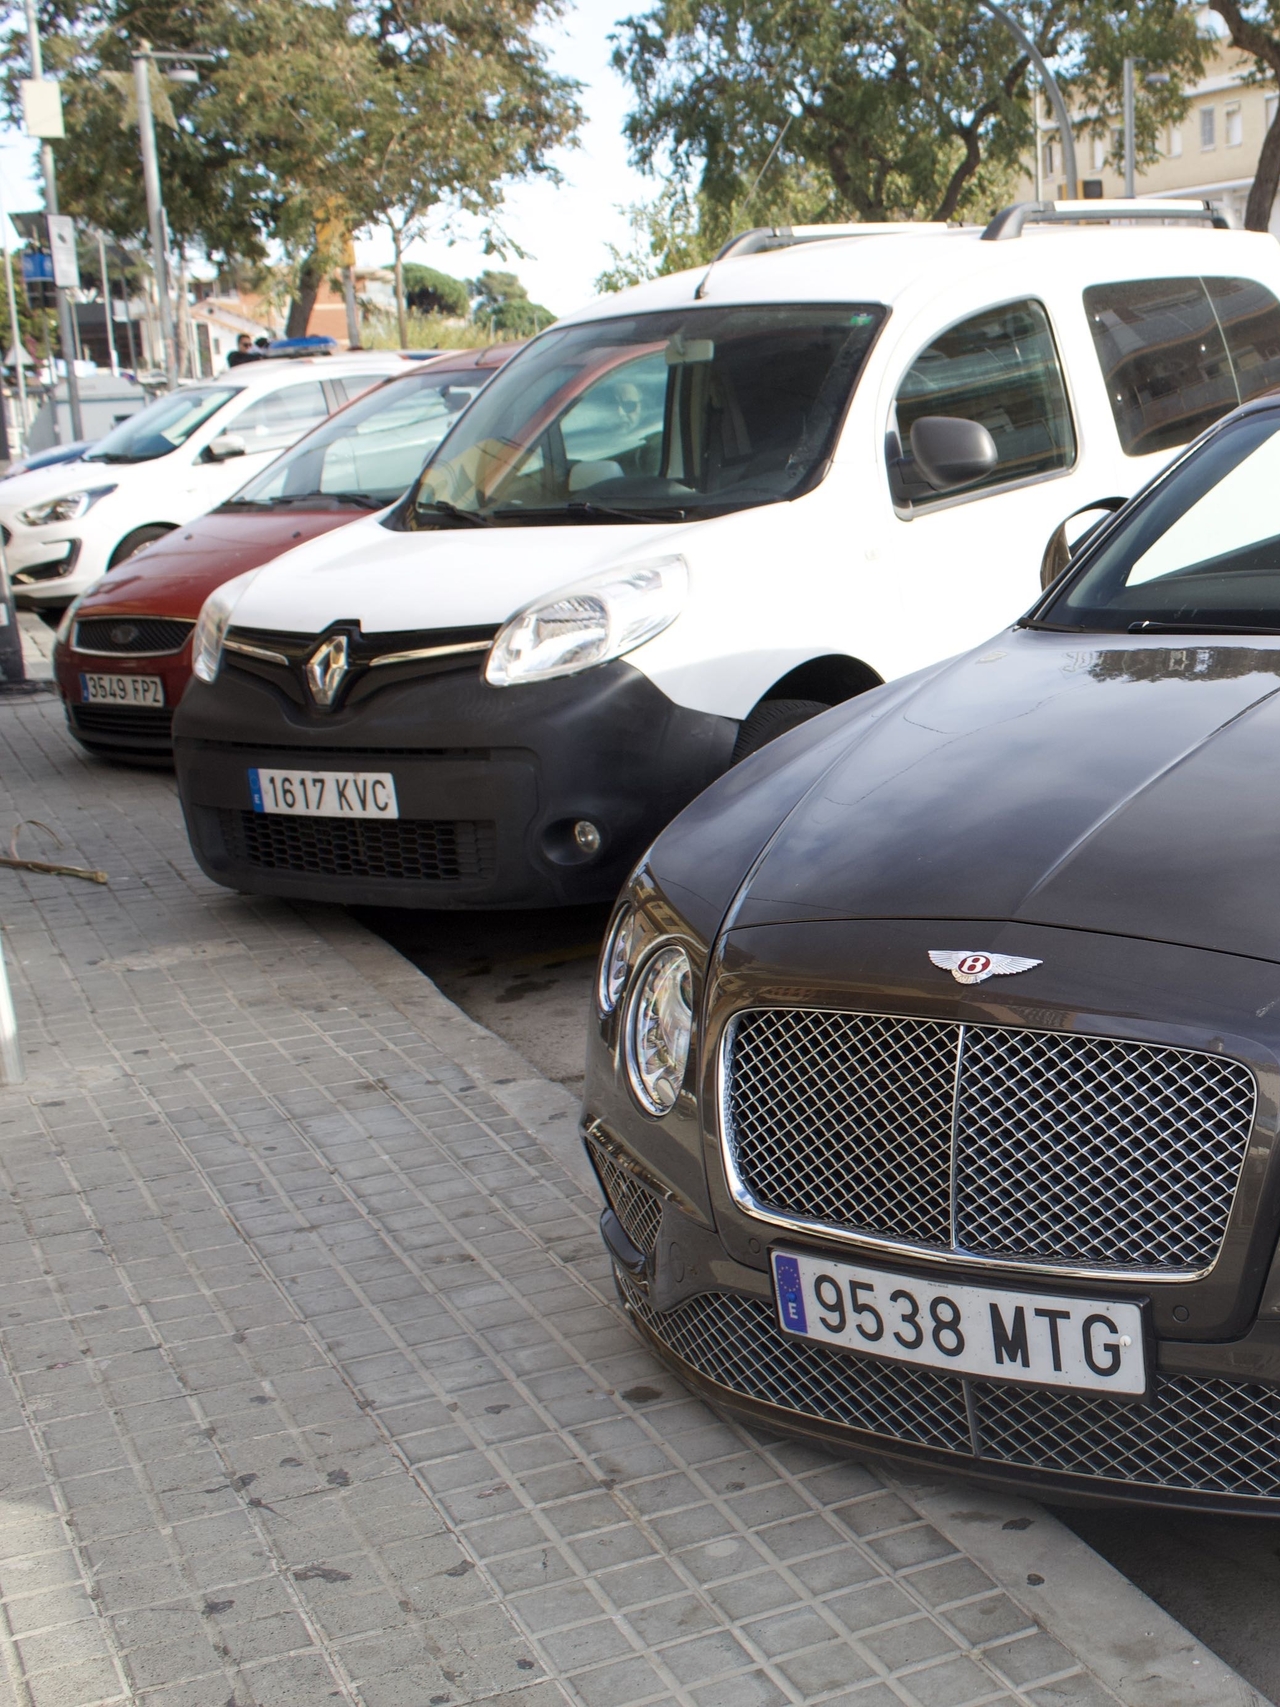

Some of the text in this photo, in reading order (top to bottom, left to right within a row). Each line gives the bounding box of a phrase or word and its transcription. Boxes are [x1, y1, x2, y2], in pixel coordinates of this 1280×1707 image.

[89, 676, 161, 703] 3549 FPZ
[269, 776, 389, 812] 1617 KVC
[788, 1302, 799, 1320] E
[814, 1274, 1122, 1377] 9538 MTG
